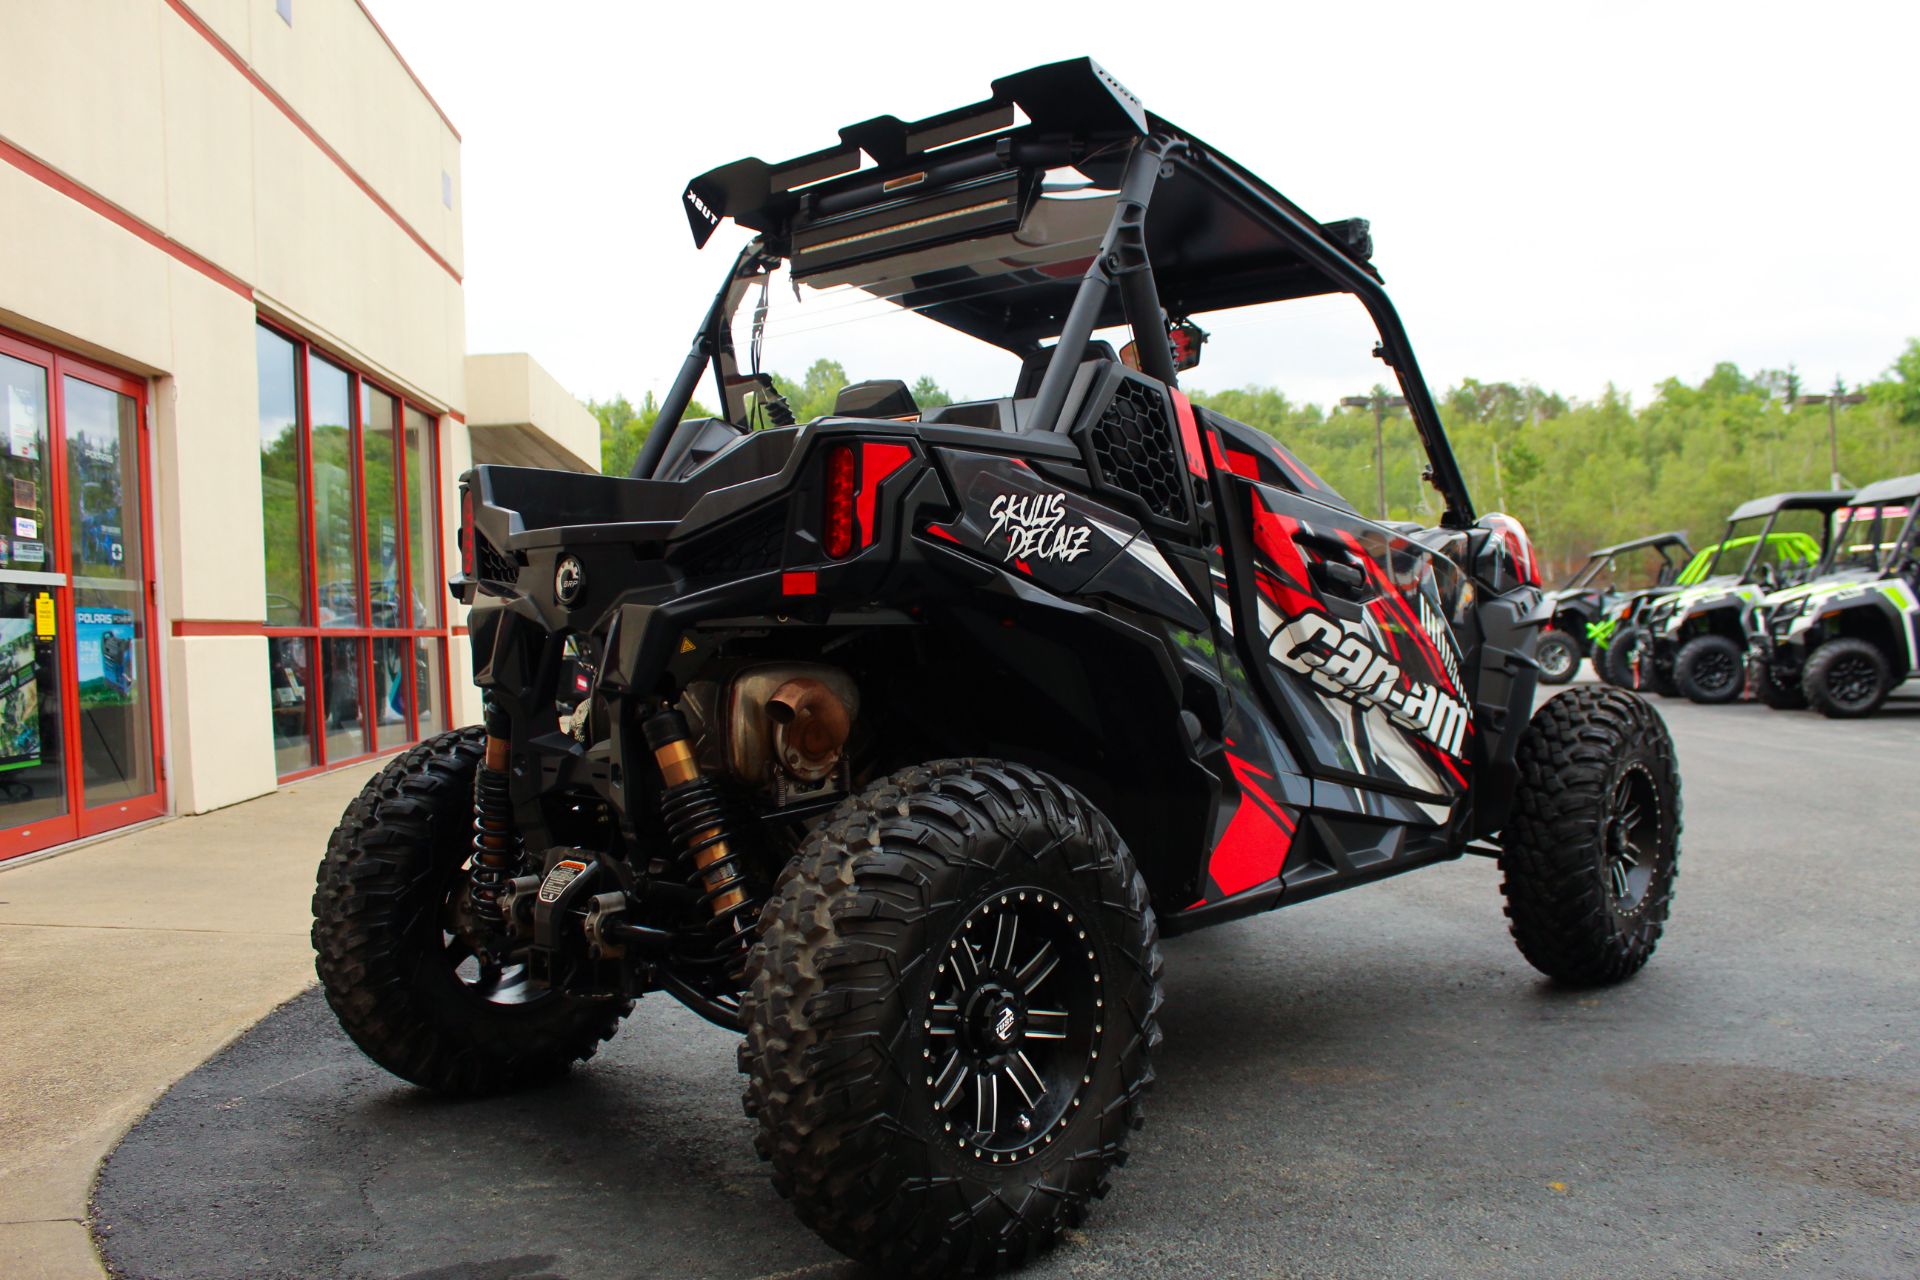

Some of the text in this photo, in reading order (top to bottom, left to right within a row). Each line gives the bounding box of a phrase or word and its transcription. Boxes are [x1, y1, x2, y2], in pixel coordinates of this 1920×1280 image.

[984, 493, 1066, 545] SKULLS
[1003, 523, 1092, 562] DECALZ
[563, 580, 578, 588] BRP
[77, 613, 112, 624] POLARIS
